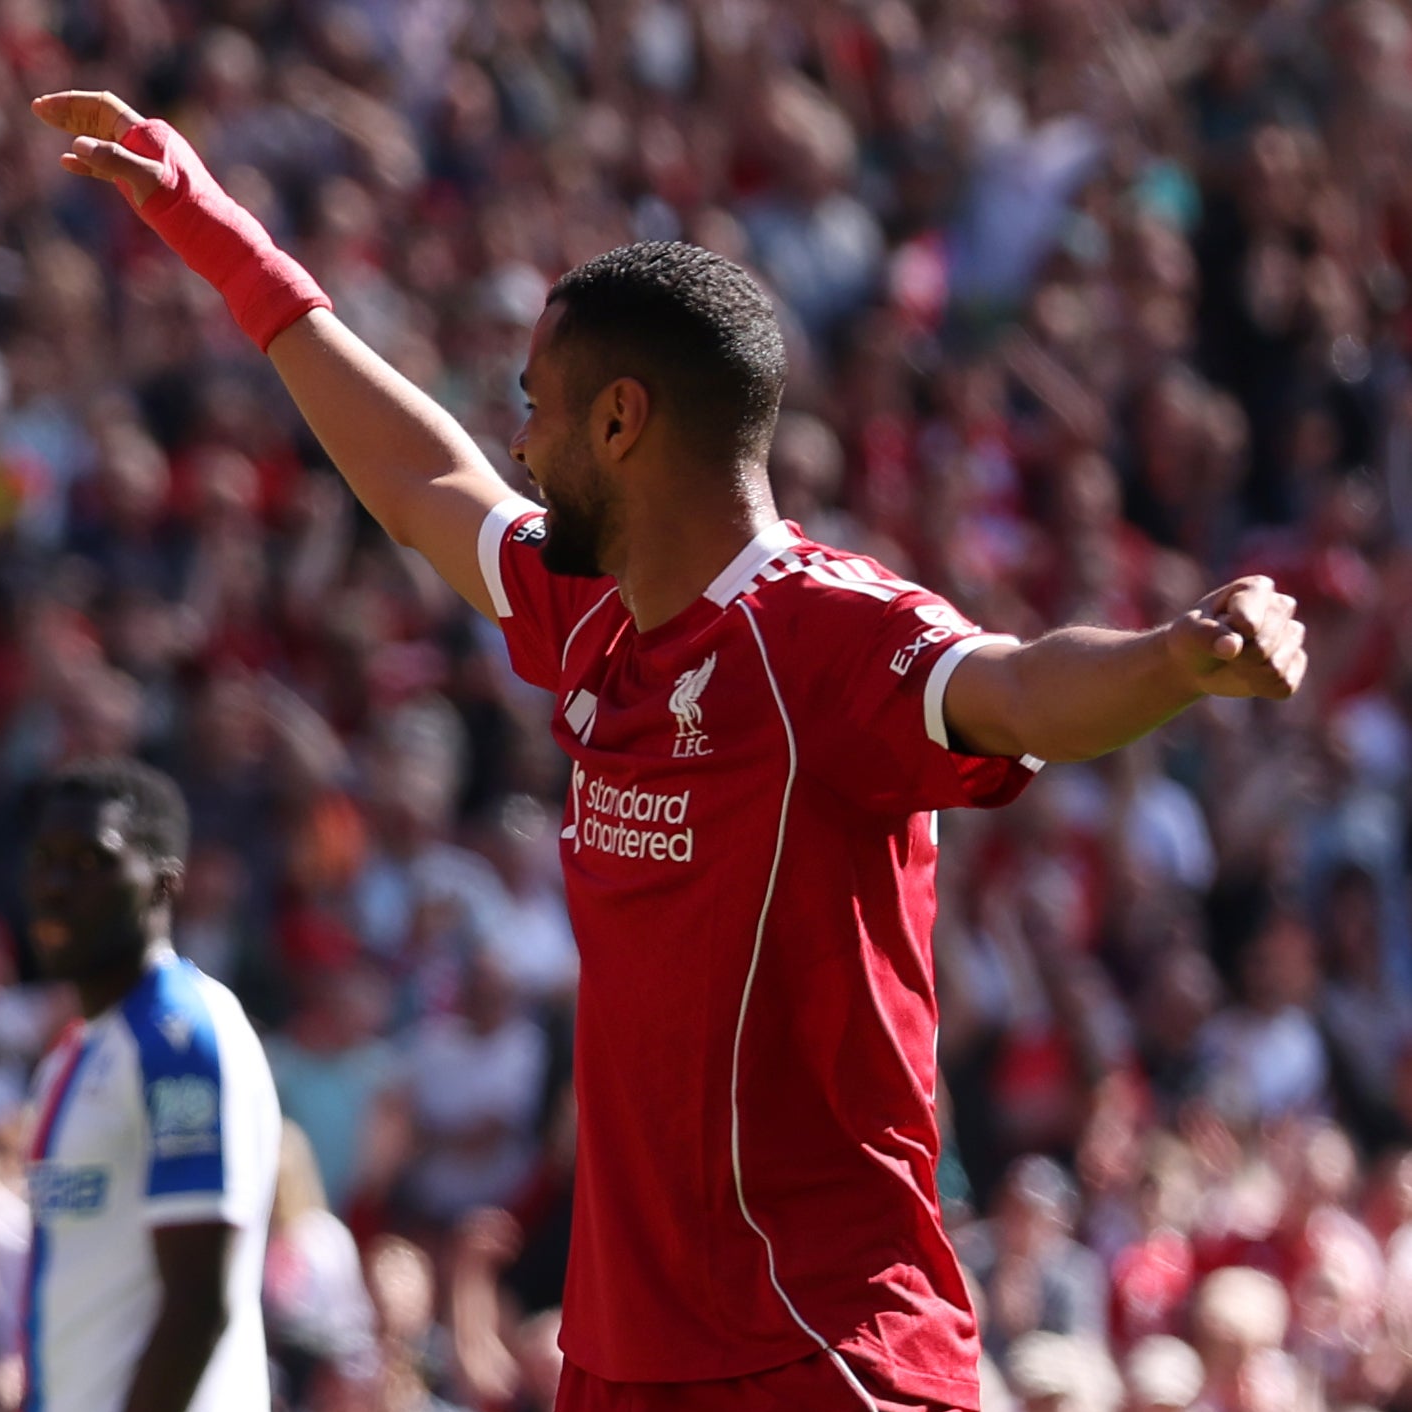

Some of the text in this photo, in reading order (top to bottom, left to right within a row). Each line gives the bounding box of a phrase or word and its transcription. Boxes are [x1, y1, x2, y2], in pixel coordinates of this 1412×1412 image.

[671, 735, 714, 758] L.F.C.
[586, 776, 690, 825] standard
[584, 814, 693, 862] chartered
